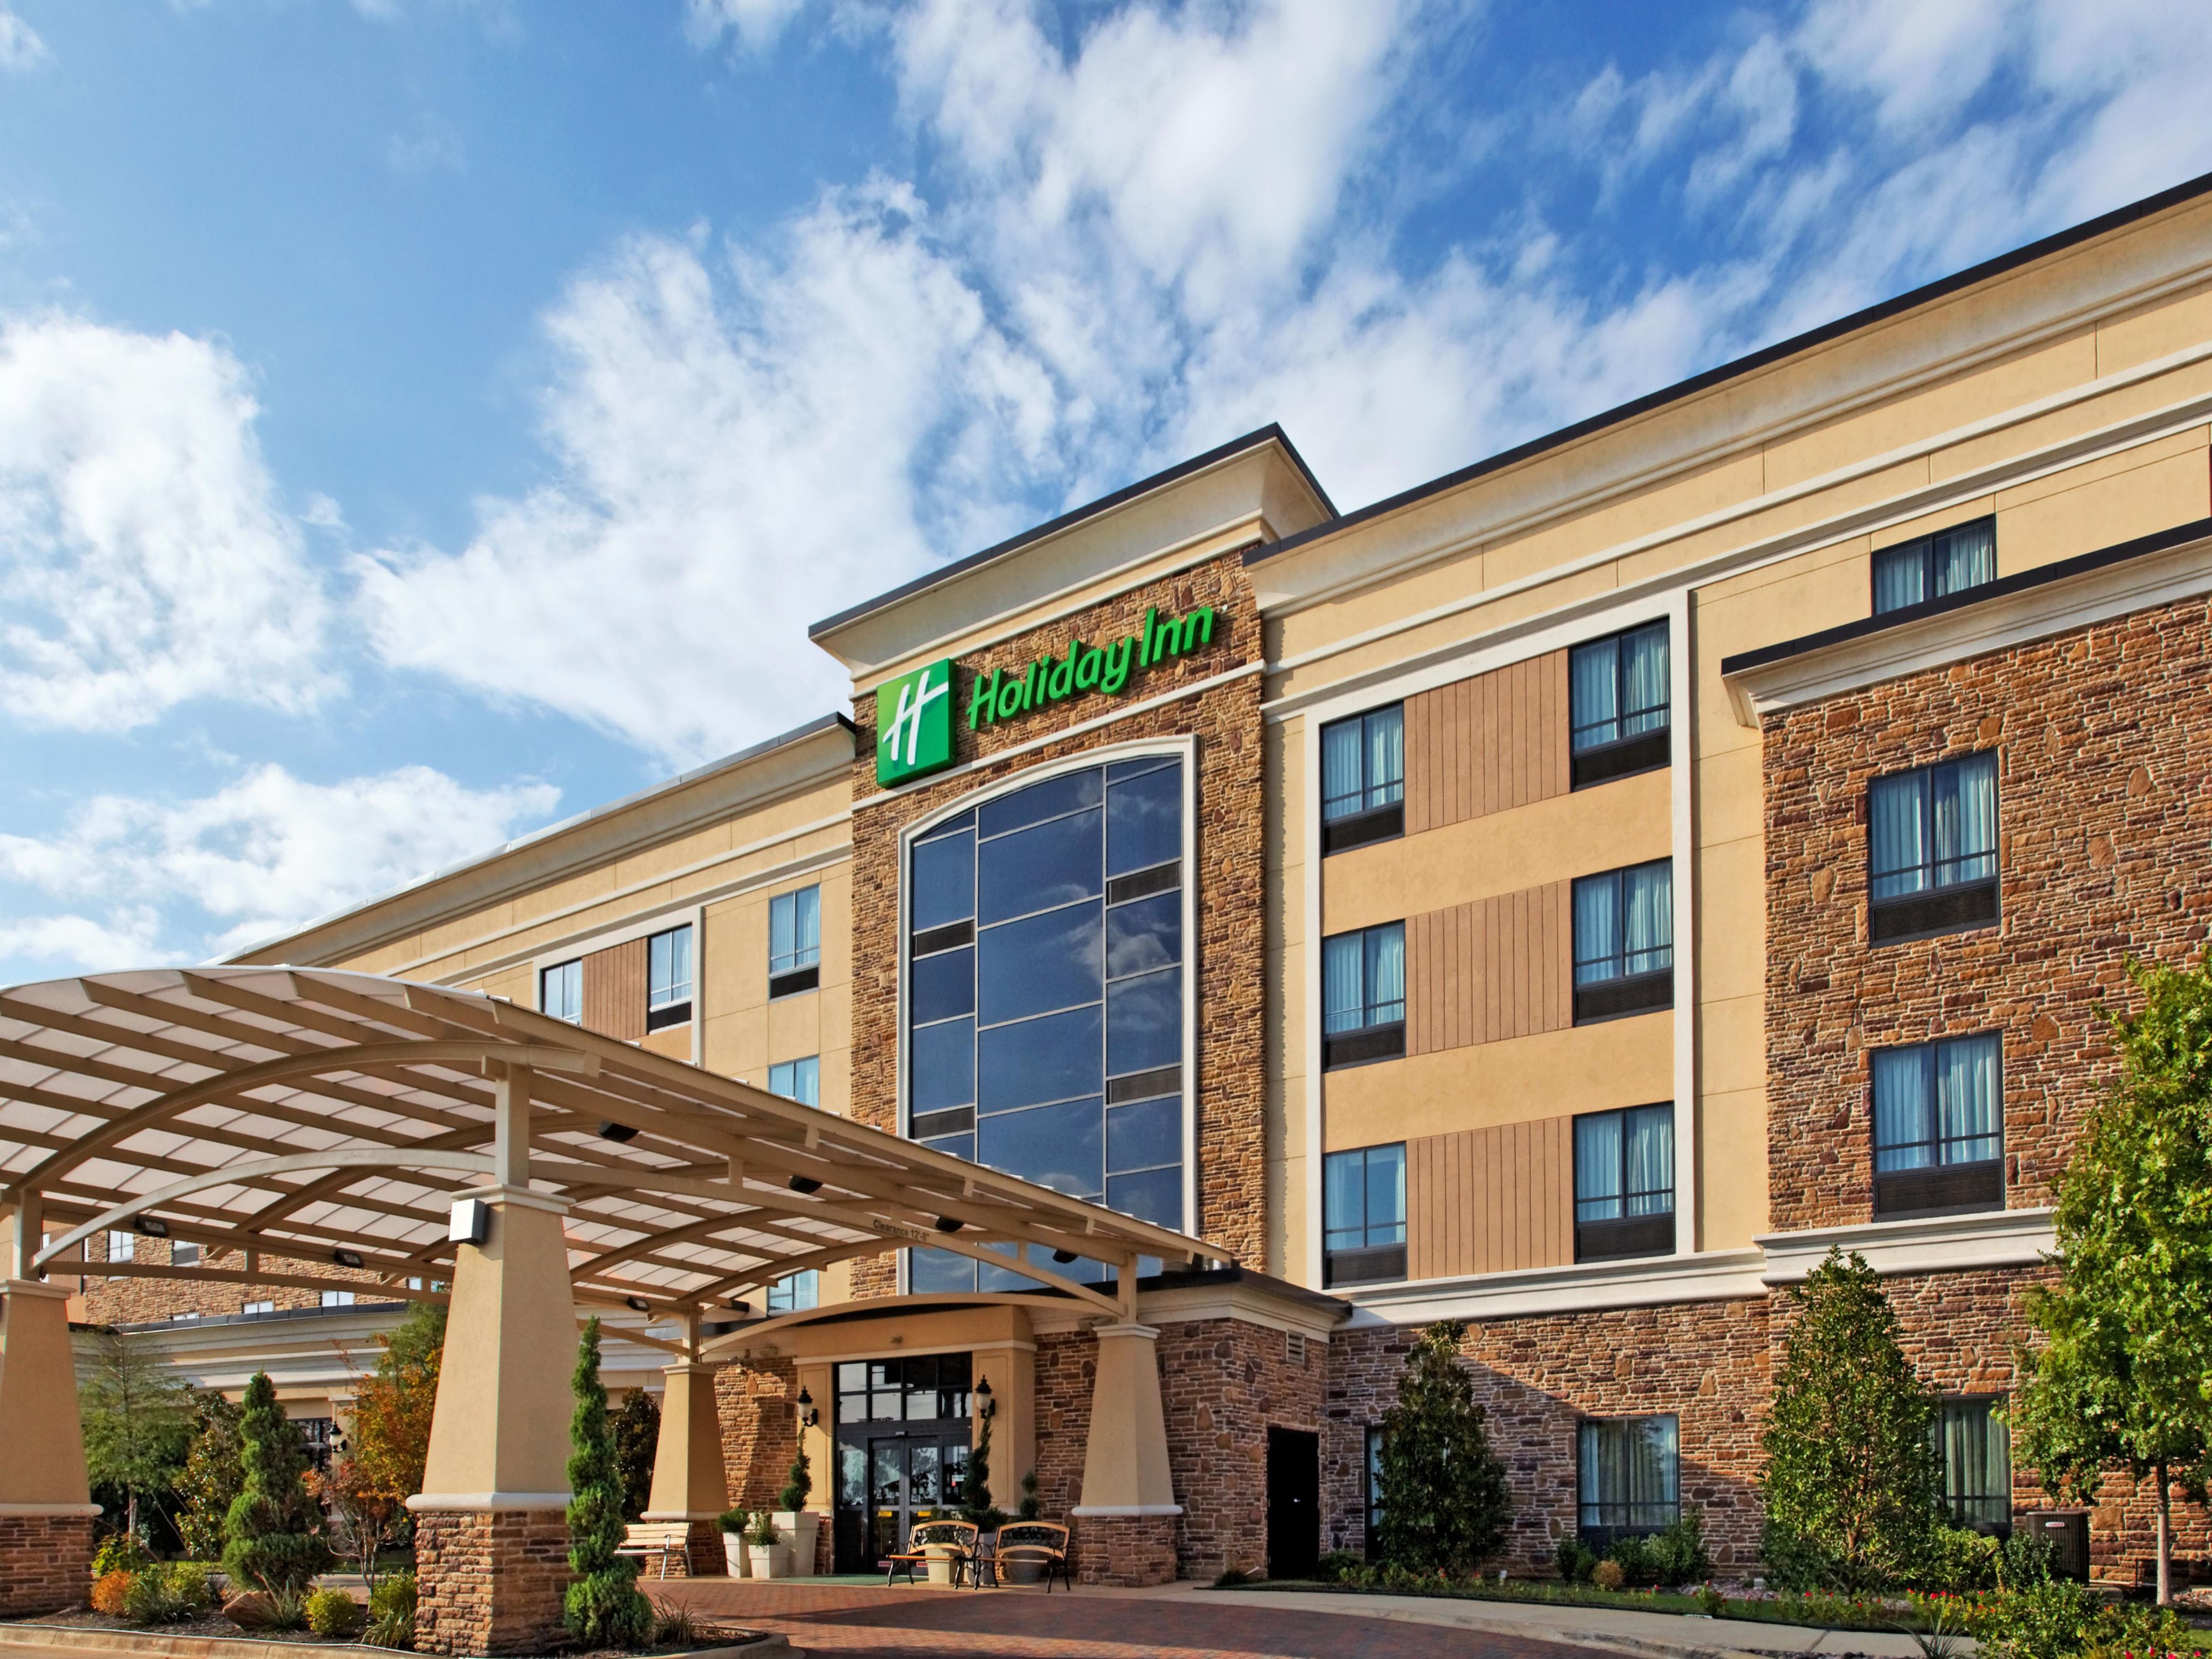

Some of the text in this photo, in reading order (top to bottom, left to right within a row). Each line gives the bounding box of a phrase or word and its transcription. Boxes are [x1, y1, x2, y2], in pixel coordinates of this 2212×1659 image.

[966, 606, 1215, 731] Holiday Inn
[873, 1219, 909, 1237] Clearance
